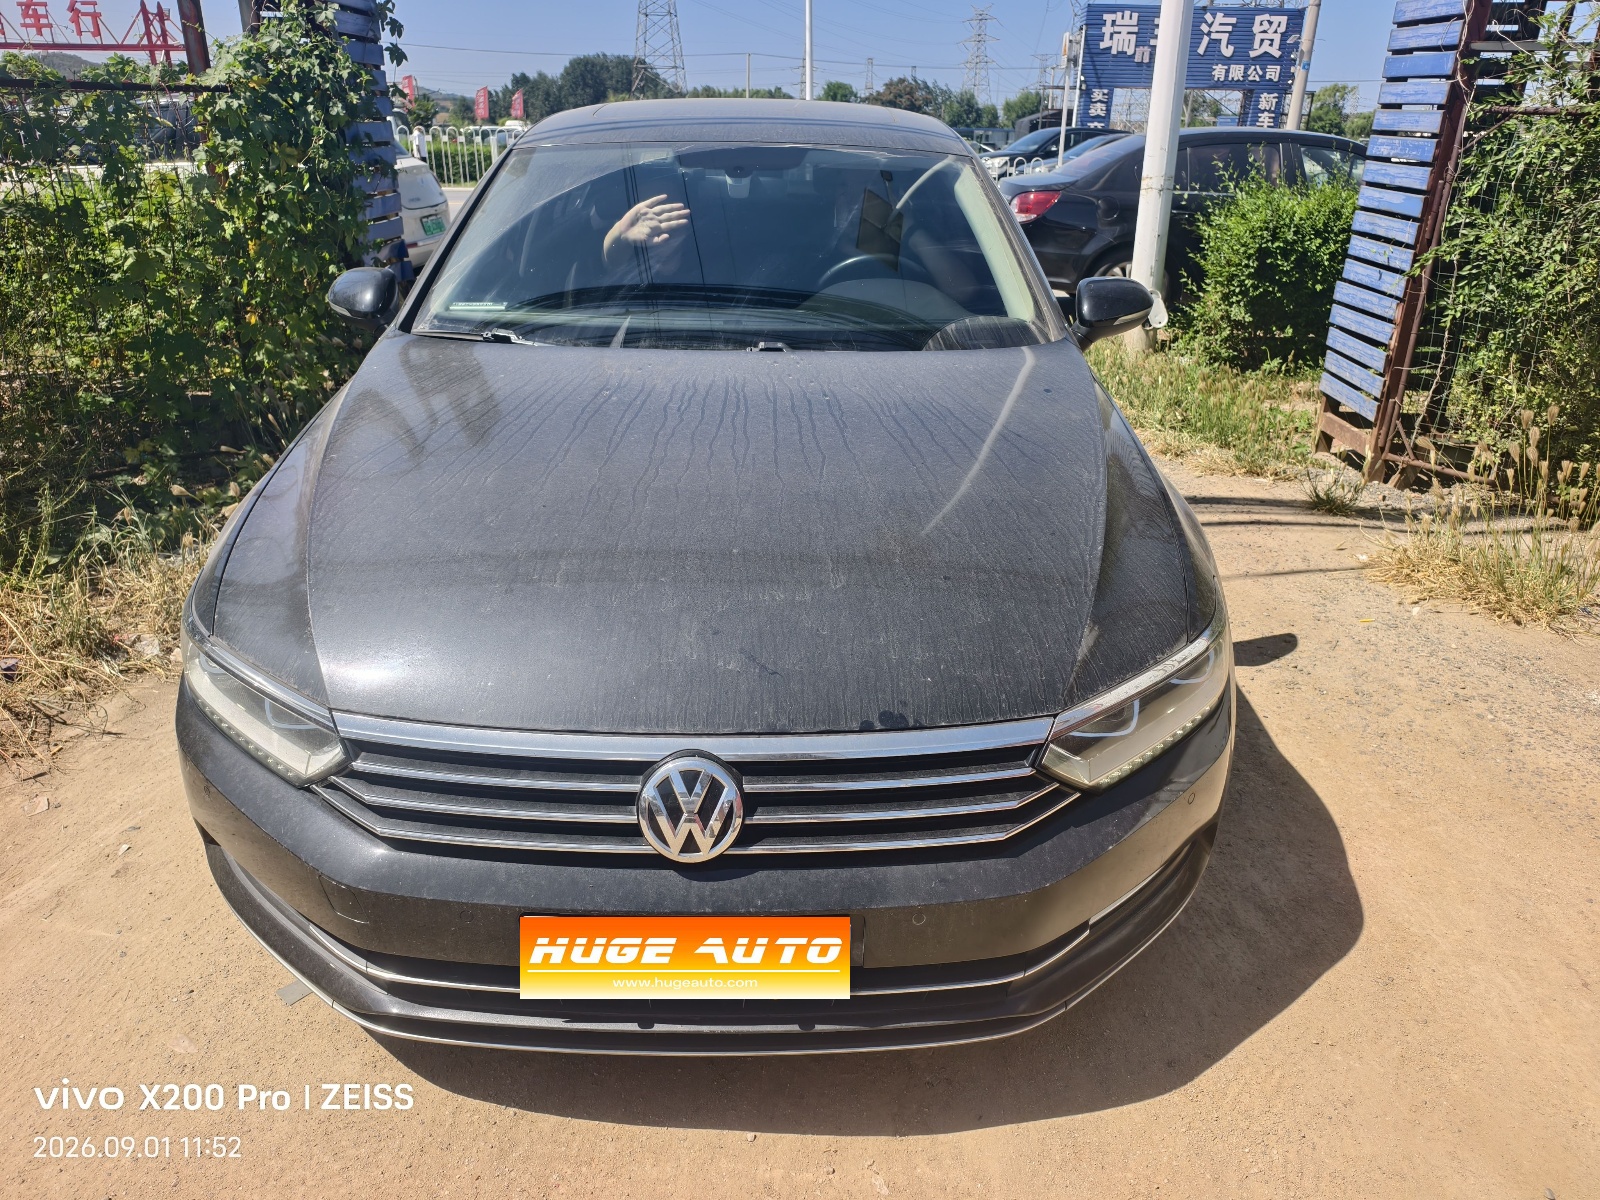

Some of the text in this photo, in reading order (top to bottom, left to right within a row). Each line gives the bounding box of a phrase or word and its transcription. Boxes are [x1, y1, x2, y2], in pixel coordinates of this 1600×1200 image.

[0, 0, 102, 38] 车行
[1212, 64, 1281, 82] 有限公司
